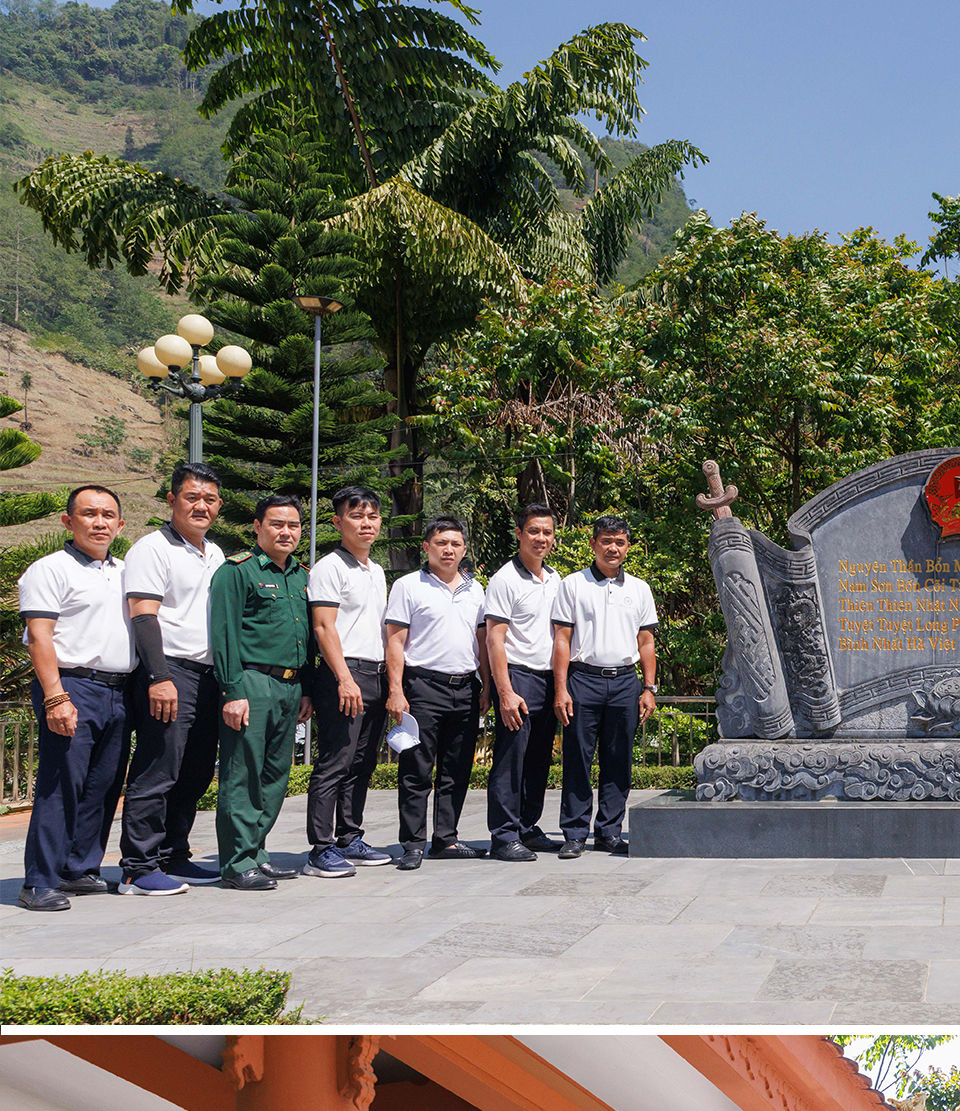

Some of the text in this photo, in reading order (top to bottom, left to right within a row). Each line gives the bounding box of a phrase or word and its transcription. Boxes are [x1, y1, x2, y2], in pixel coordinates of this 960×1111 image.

[839, 579, 867, 592] Nam
[871, 578, 893, 592] Sơn
[897, 578, 921, 592] Bốn
[924, 579, 946, 592] Cõi
[839, 599, 874, 611] Thiên
[877, 599, 913, 611] Thiên
[916, 599, 946, 614] Nhật
[839, 618, 874, 634] Tuyệt
[877, 618, 913, 634] Tuyệt
[916, 618, 948, 634] Long
[839, 637, 868, 650] Bình
[872, 636, 903, 650] Nhất
[907, 637, 925, 650] Hà
[928, 637, 956, 653] Việt
